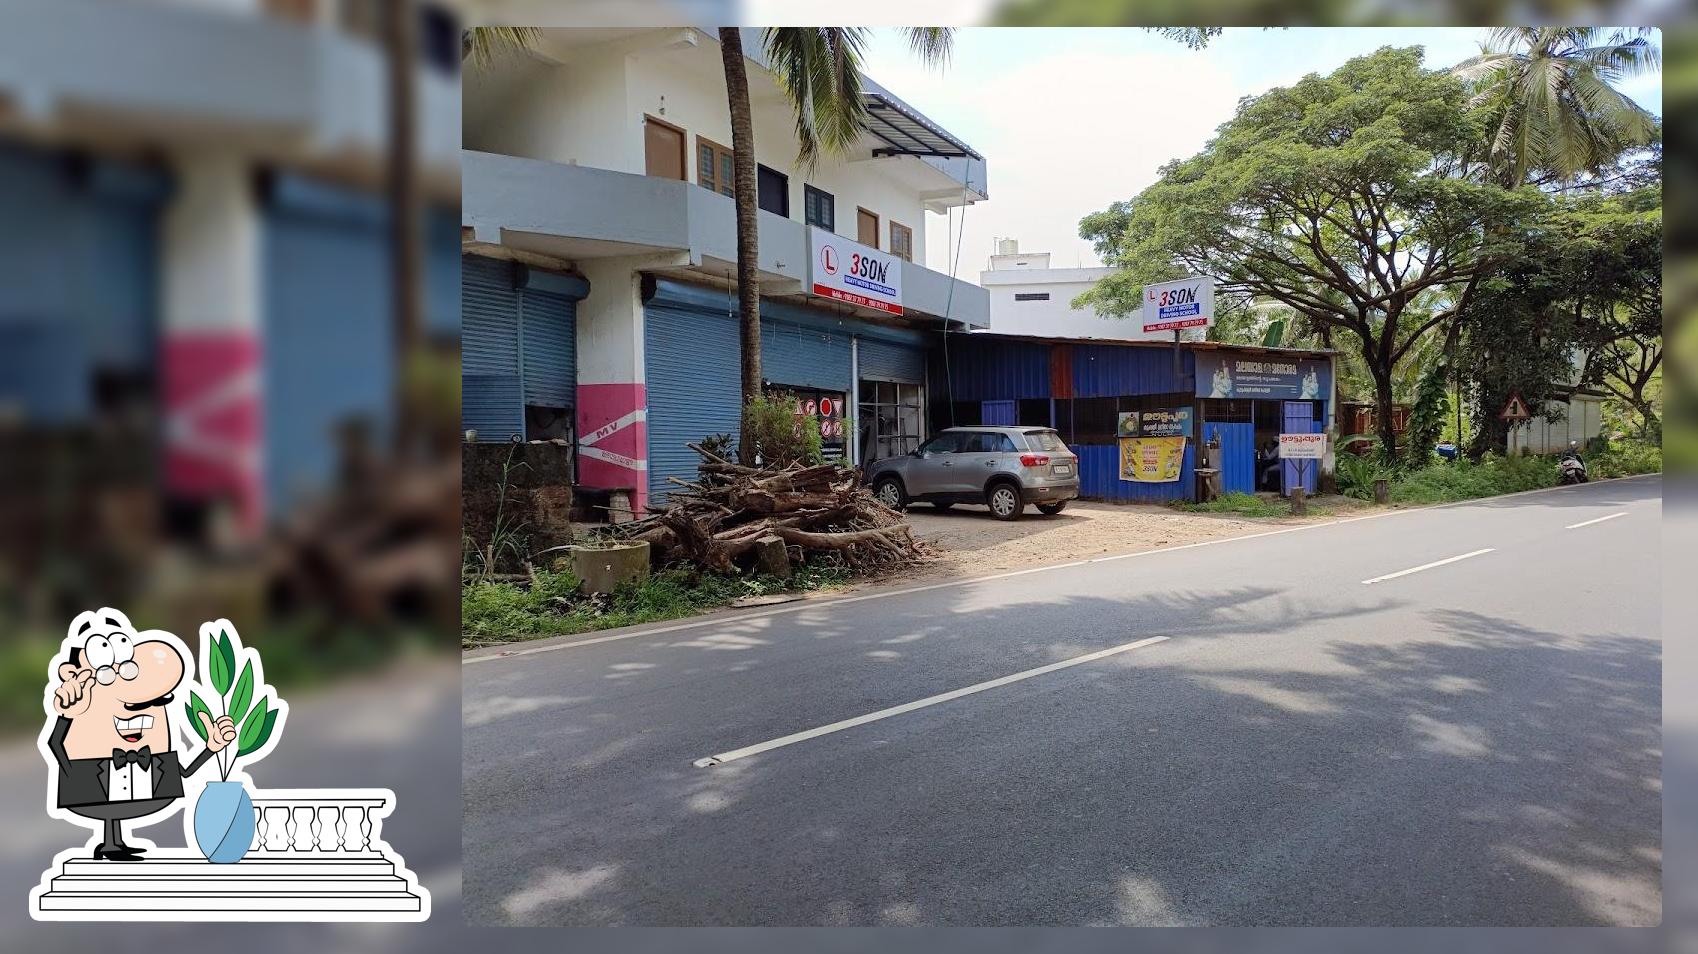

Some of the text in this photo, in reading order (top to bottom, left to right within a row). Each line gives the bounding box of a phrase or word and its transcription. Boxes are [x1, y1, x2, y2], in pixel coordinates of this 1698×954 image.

[826, 250, 835, 271] L
[850, 253, 890, 283] 3SON
[1159, 284, 1200, 306] 3SON
